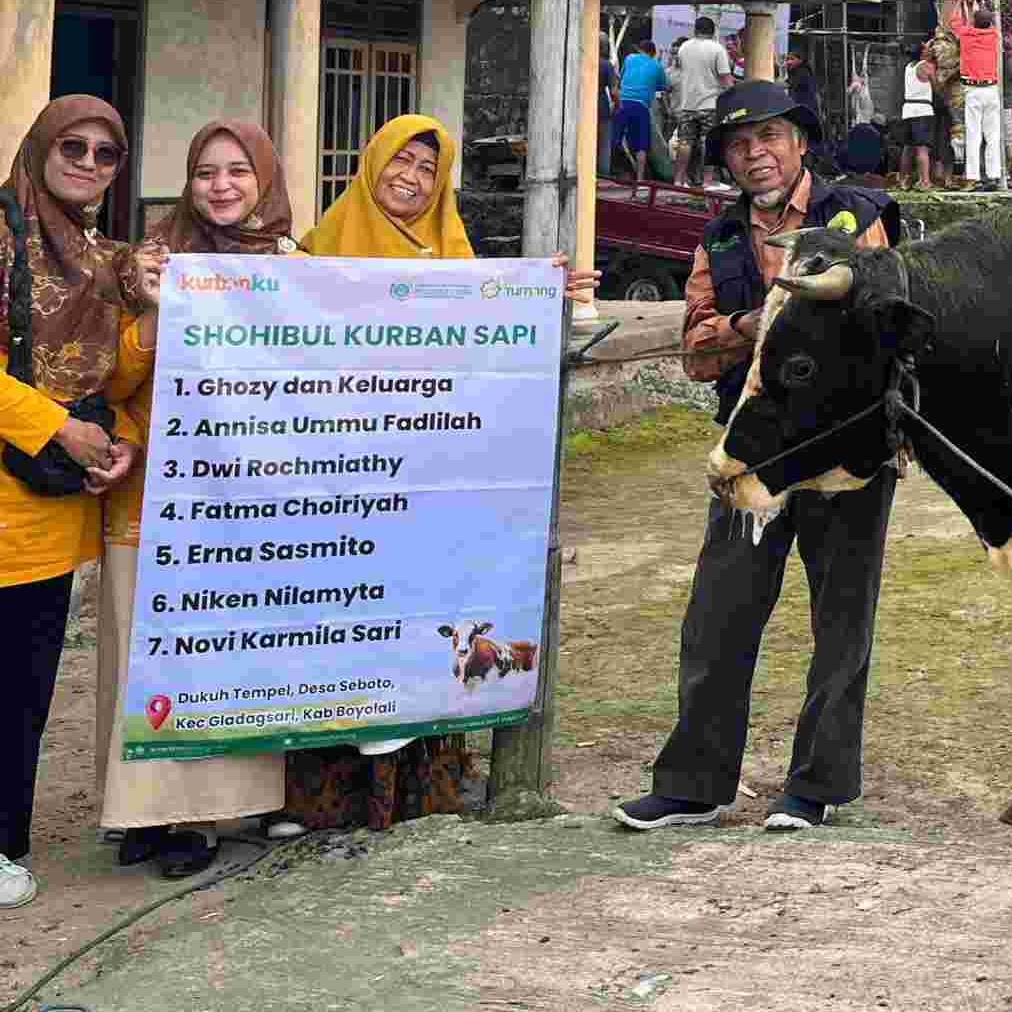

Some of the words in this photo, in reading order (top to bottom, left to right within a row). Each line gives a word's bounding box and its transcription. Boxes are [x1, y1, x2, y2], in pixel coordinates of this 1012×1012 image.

[183, 325, 337, 347] SHOHIBUL
[344, 325, 466, 346] KURBAN
[473, 325, 536, 345] SAPI
[173, 378, 191, 396] 1.
[197, 378, 275, 400] Ghozy
[284, 376, 332, 395] dan
[338, 375, 453, 398] Keluarga
[166, 418, 188, 437] 2.
[195, 417, 286, 437] Annisa
[292, 416, 377, 434] Ummu
[383, 412, 481, 431] Fadlilah
[163, 459, 185, 479] 3.
[191, 459, 241, 478] Dwi
[247, 455, 403, 477] Rochmiathy
[159, 502, 184, 520] 4.
[191, 501, 277, 519] Fatma
[283, 494, 409, 518] Choiriyah
[155, 545, 180, 565] 5.
[187, 543, 252, 564] Erna
[259, 536, 376, 561] Sasmito
[152, 594, 174, 613] 6.
[180, 590, 258, 611] Niken
[264, 583, 385, 608] Nilamyta
[148, 637, 169, 656] 7.
[175, 632, 236, 656] Novi
[241, 624, 346, 650] Karmila
[352, 620, 402, 642] Sari
[178, 690, 229, 704] Dukuh
[234, 684, 294, 702] Tempel,
[298, 681, 335, 696] Desa
[176, 715, 206, 729] Kec
[302, 706, 334, 720] Kab
